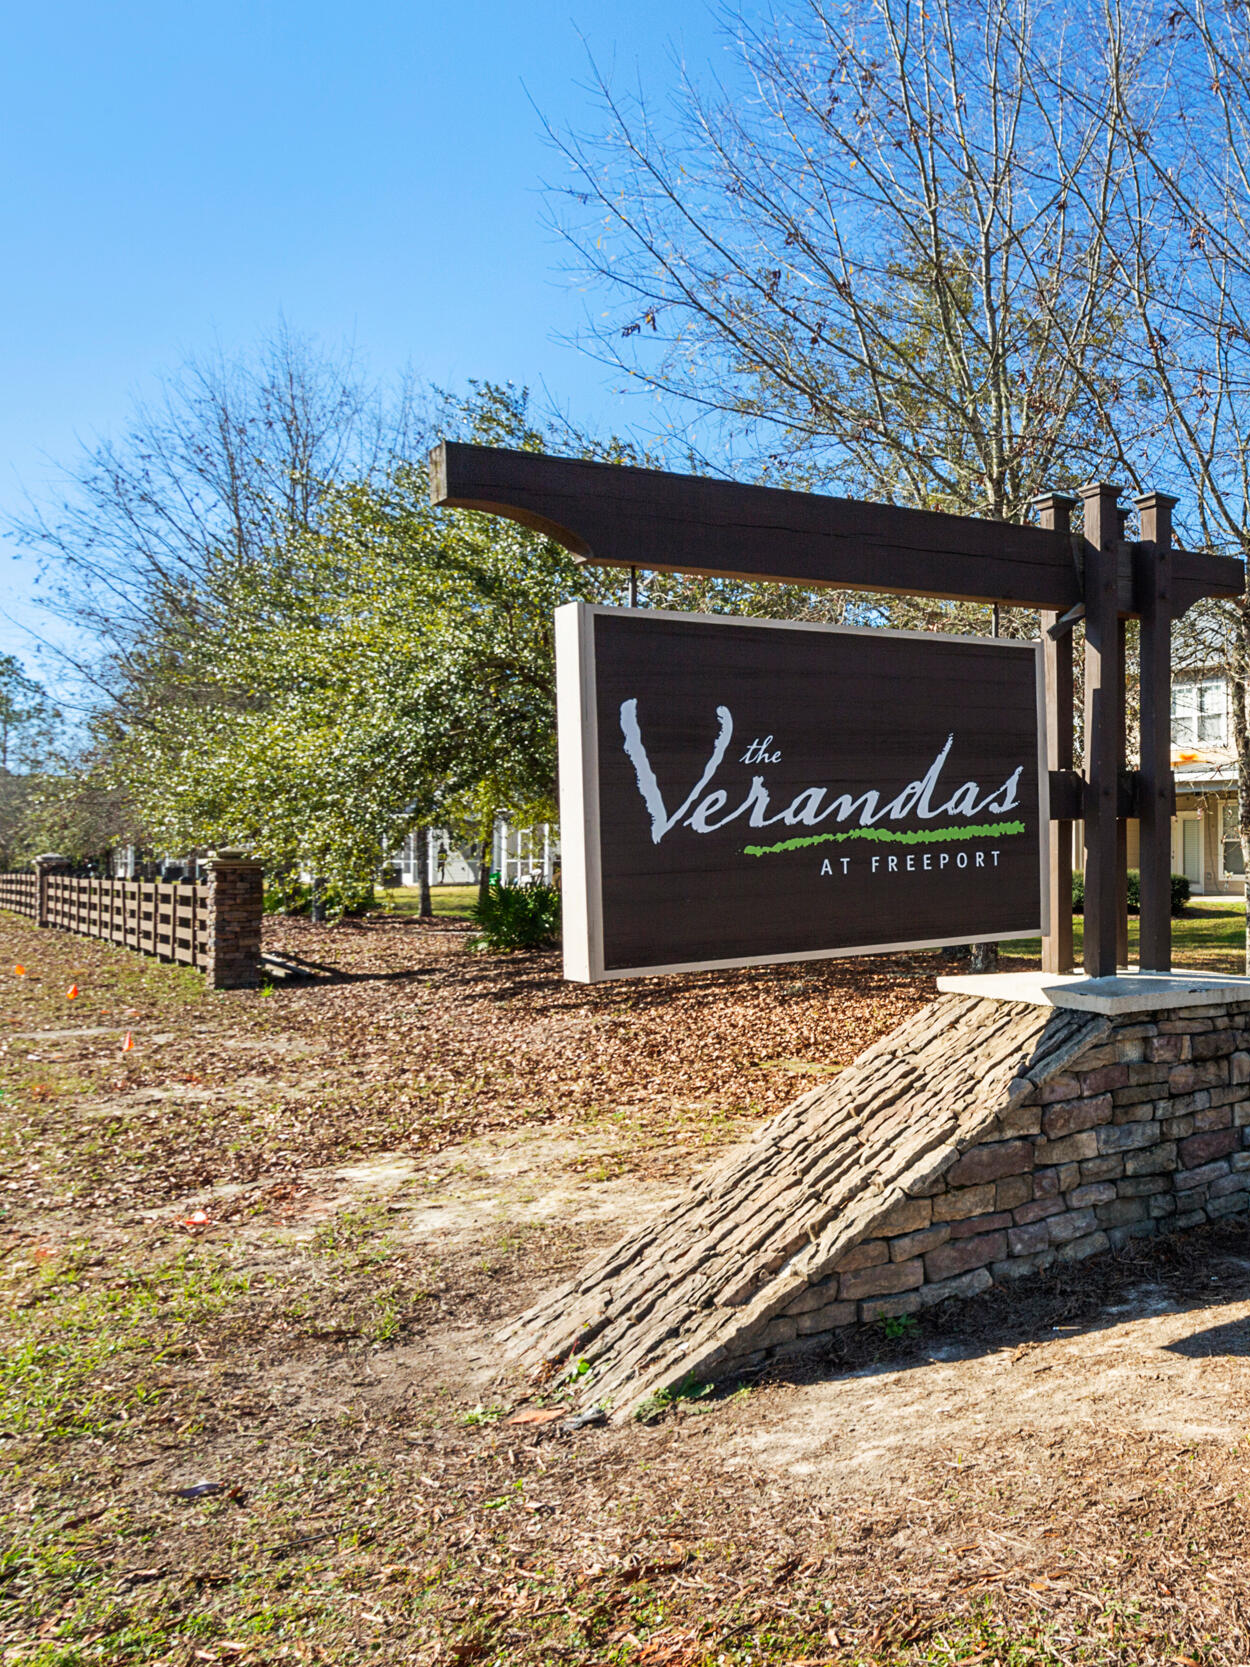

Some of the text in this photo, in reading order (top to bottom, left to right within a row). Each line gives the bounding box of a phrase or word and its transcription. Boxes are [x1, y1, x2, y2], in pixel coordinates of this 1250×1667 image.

[739, 735, 782, 765] the
[620, 698, 1024, 845] Verandas
[820, 850, 1001, 876] AT FREEPORT
